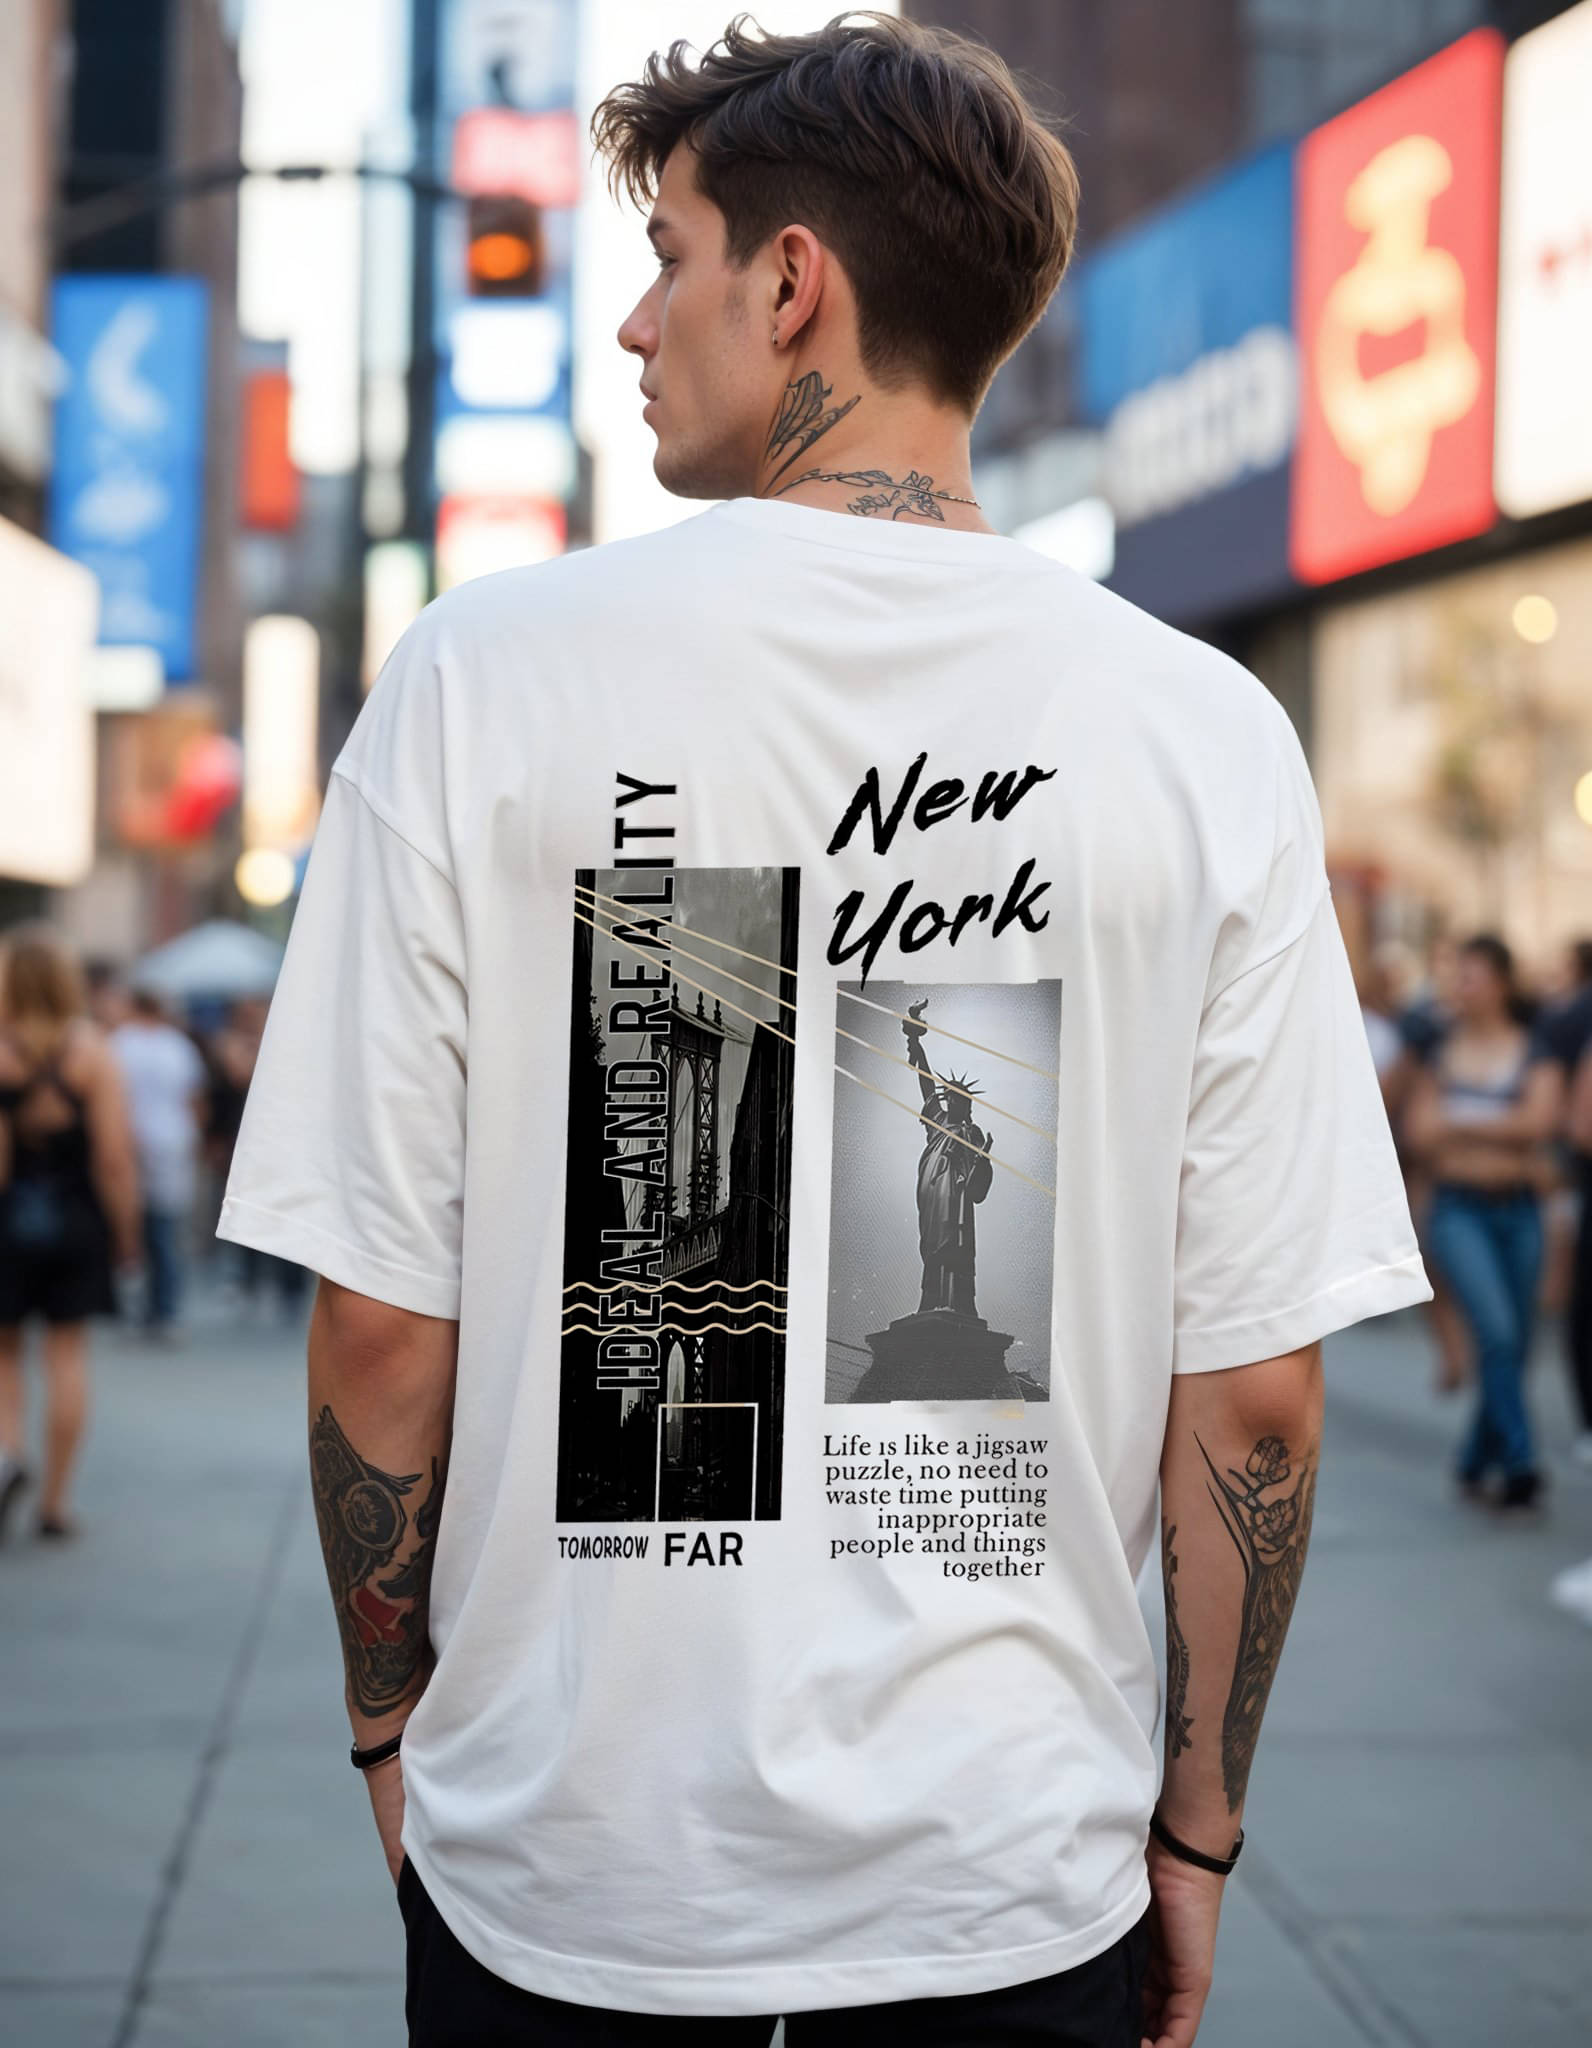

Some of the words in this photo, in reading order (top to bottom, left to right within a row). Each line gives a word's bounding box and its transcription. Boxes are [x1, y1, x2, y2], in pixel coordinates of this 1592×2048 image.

[827, 752, 1058, 856] New
[609, 771, 677, 1034] REALITY
[827, 858, 1052, 993] York
[604, 1060, 669, 1185] AND
[597, 1211, 665, 1389] IDEAL
[823, 1434, 871, 1456] Life
[905, 1434, 949, 1456] like
[956, 1440, 969, 1455] a
[972, 1433, 1049, 1460] jigsaw
[825, 1458, 912, 1486] puzzle,
[920, 1465, 951, 1480] no
[958, 1457, 1017, 1480] need
[1025, 1461, 1049, 1479] to
[826, 1487, 891, 1505] waste
[899, 1482, 953, 1505] time
[960, 1481, 1048, 1509] putting
[877, 1506, 1048, 1534] inappropriate
[558, 1535, 650, 1560] TOMORROW
[664, 1531, 744, 1567] FAR
[830, 1532, 914, 1559] people
[921, 1531, 966, 1553] and
[974, 1531, 1047, 1558] things
[943, 1555, 1046, 1582] together
